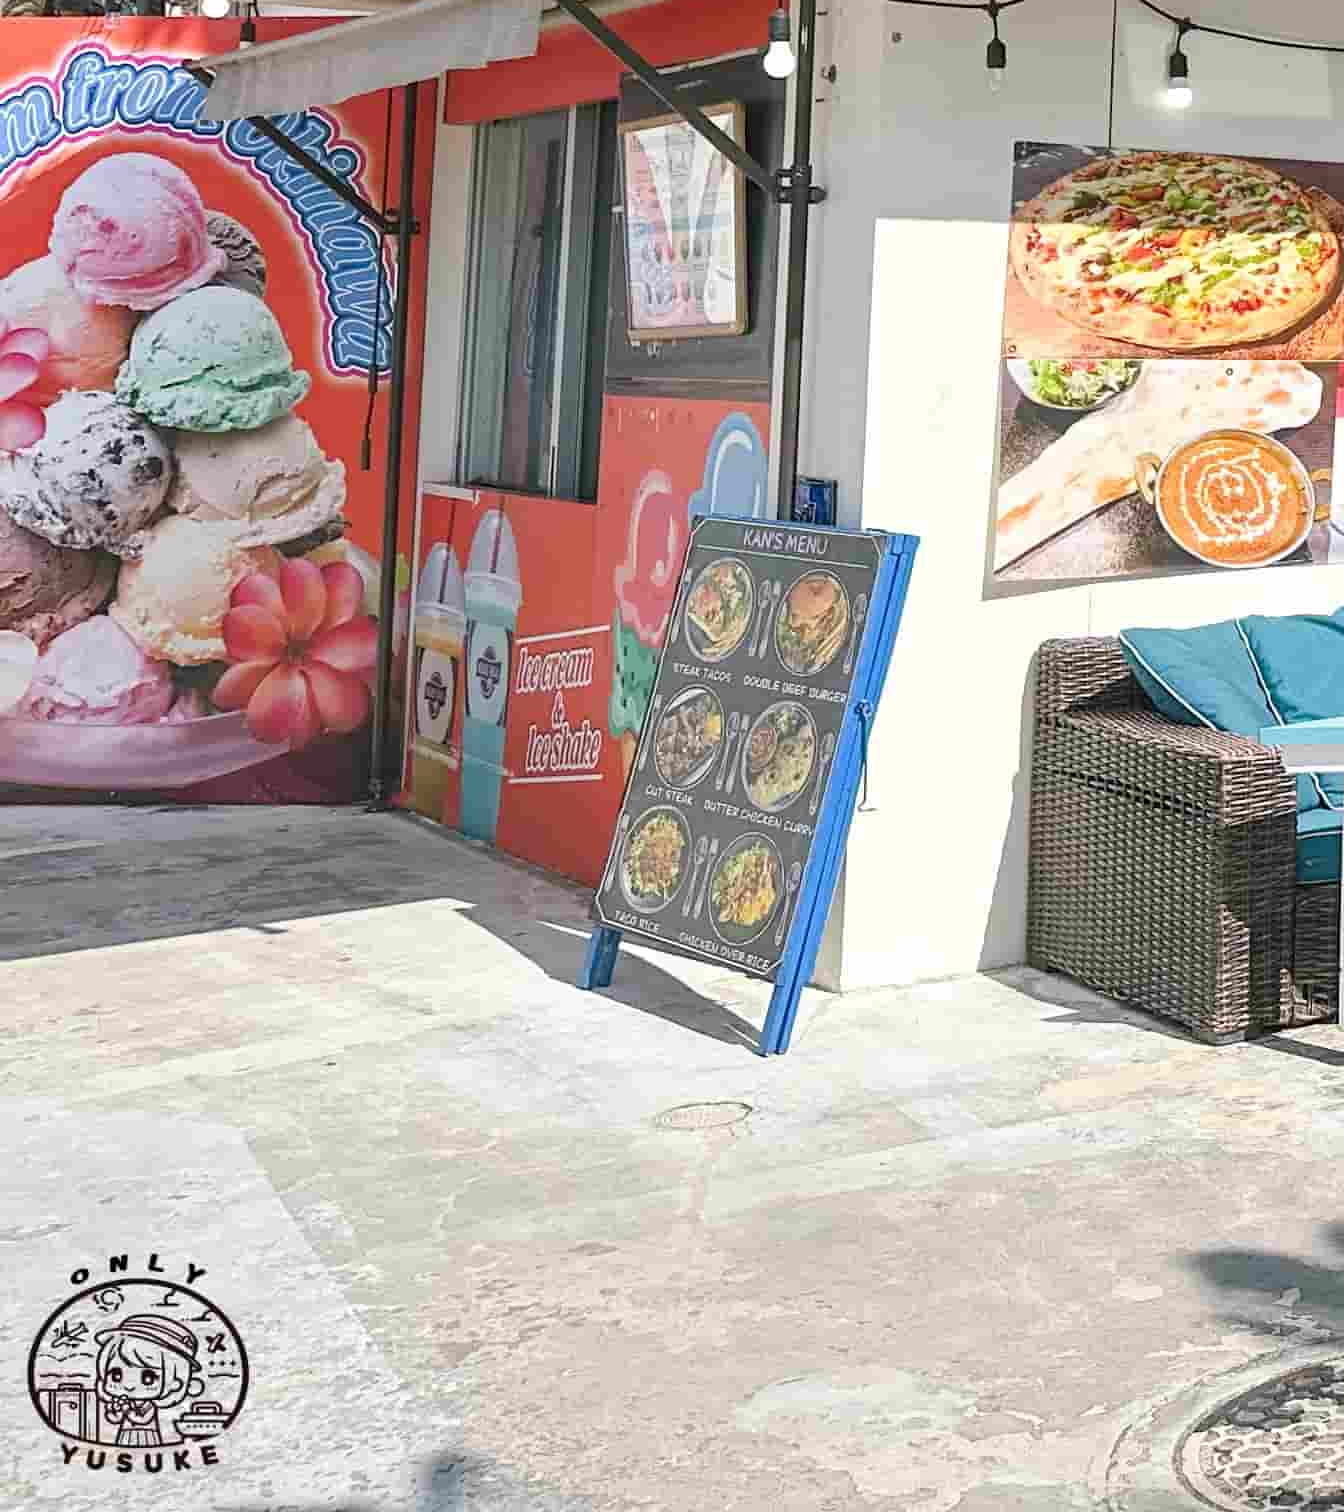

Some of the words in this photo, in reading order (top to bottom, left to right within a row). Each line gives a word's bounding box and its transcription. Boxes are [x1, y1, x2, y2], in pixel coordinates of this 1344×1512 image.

[743, 529, 785, 551] KAN'S
[785, 534, 829, 555] MENU
[515, 647, 542, 694] Ice
[541, 647, 594, 690] cream
[703, 668, 733, 683] TACOS
[526, 724, 551, 774] Ice
[550, 719, 602, 771] shake
